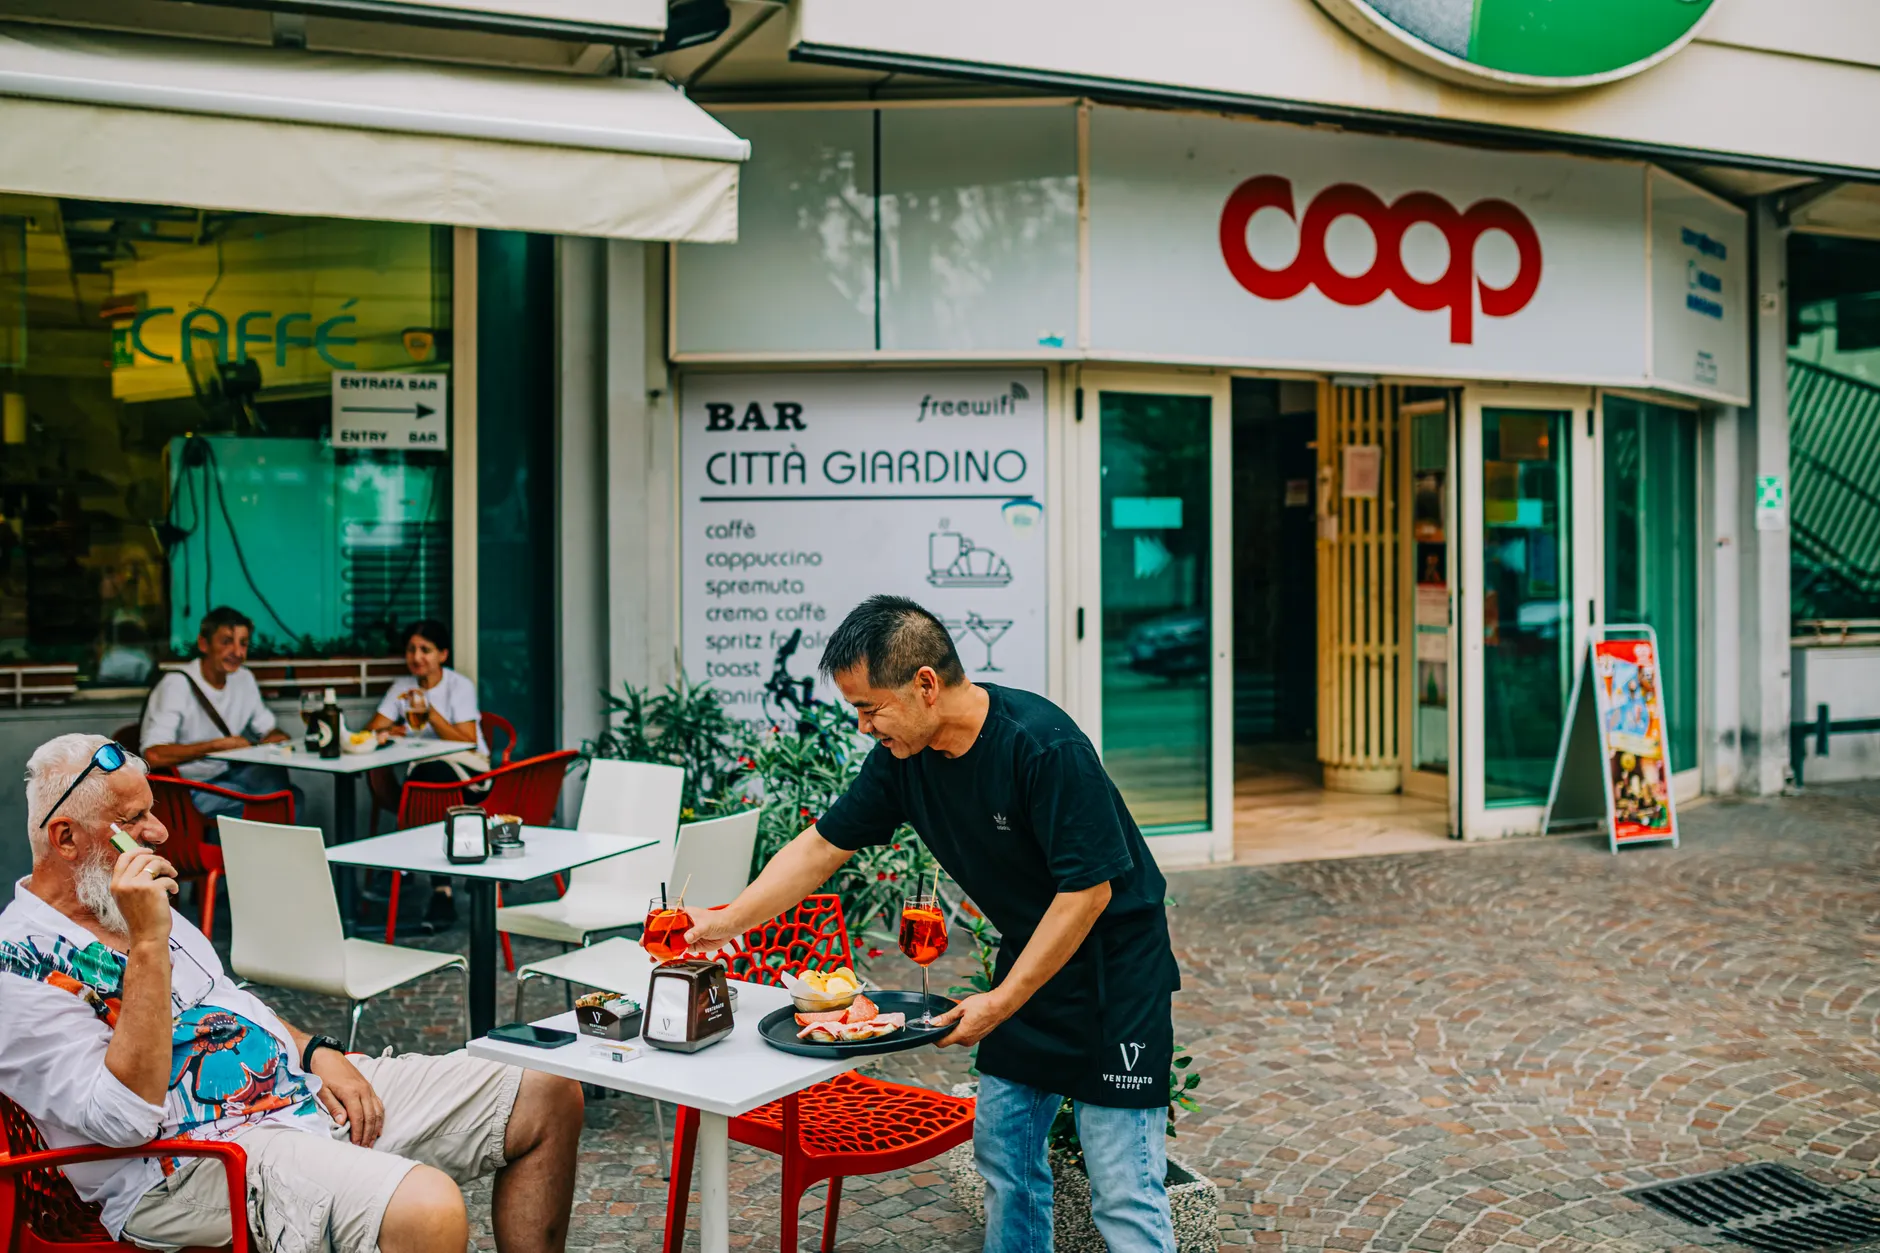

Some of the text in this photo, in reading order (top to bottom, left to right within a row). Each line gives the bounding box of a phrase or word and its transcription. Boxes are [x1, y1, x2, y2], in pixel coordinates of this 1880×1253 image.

[1219, 174, 1543, 344] coop
[340, 376, 438, 390] ENTRATA BAR
[705, 401, 807, 432] BAR
[916, 394, 1017, 422] freewifi
[340, 429, 438, 443] ENTRY BAR
[706, 442, 1027, 485] CITTÀ GIARDINO
[705, 551, 822, 572] cappuccino
[705, 577, 805, 599] spremuta
[705, 606, 768, 621] crema
[705, 632, 762, 654] spritz
[705, 659, 761, 677] toast
[1102, 1073, 1153, 1085] VENTURATO
